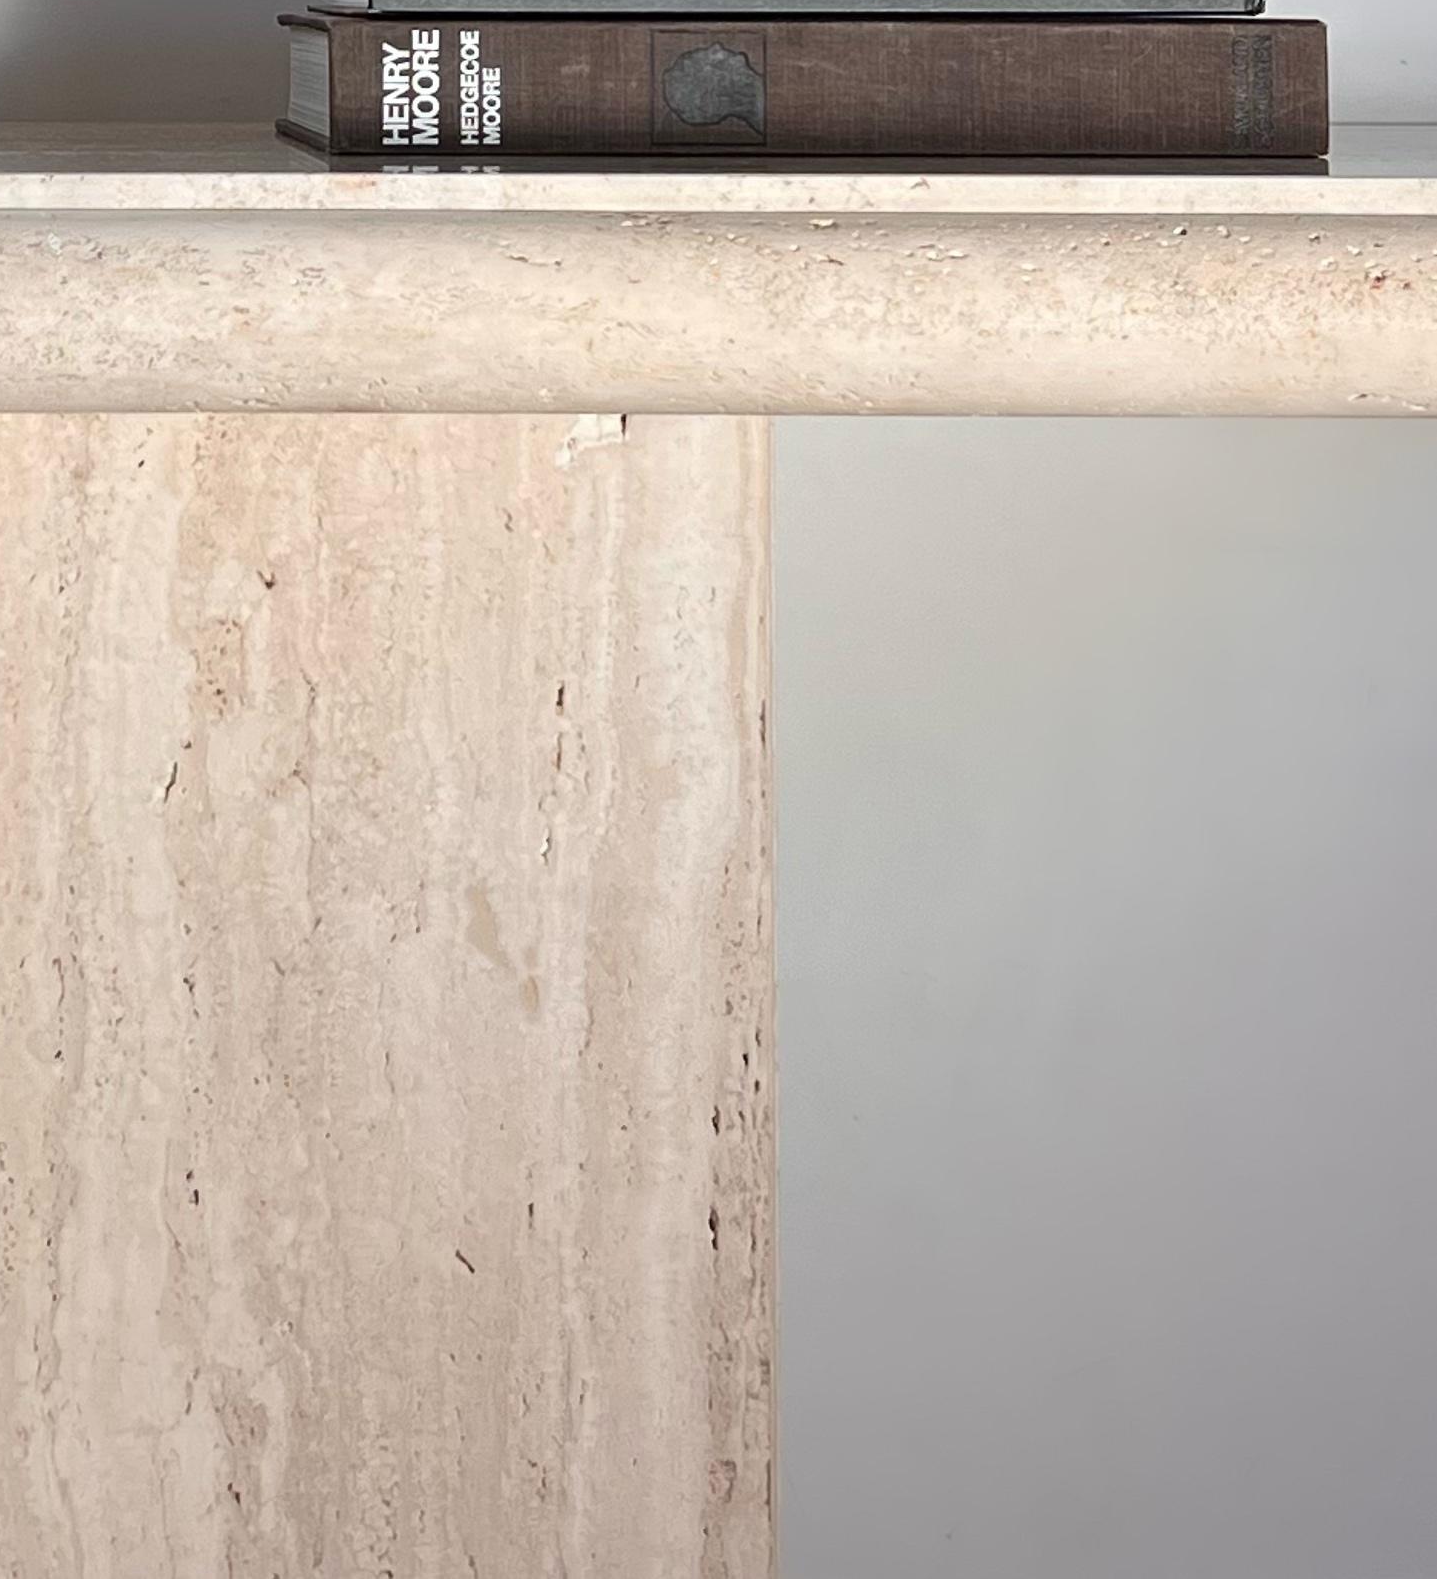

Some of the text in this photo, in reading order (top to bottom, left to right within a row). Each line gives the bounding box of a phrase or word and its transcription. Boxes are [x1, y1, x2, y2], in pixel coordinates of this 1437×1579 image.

[382, 42, 410, 145] HENRY
[411, 29, 440, 145] MOORE
[460, 30, 480, 145] HEDGECOE
[482, 67, 501, 145] MOORE
